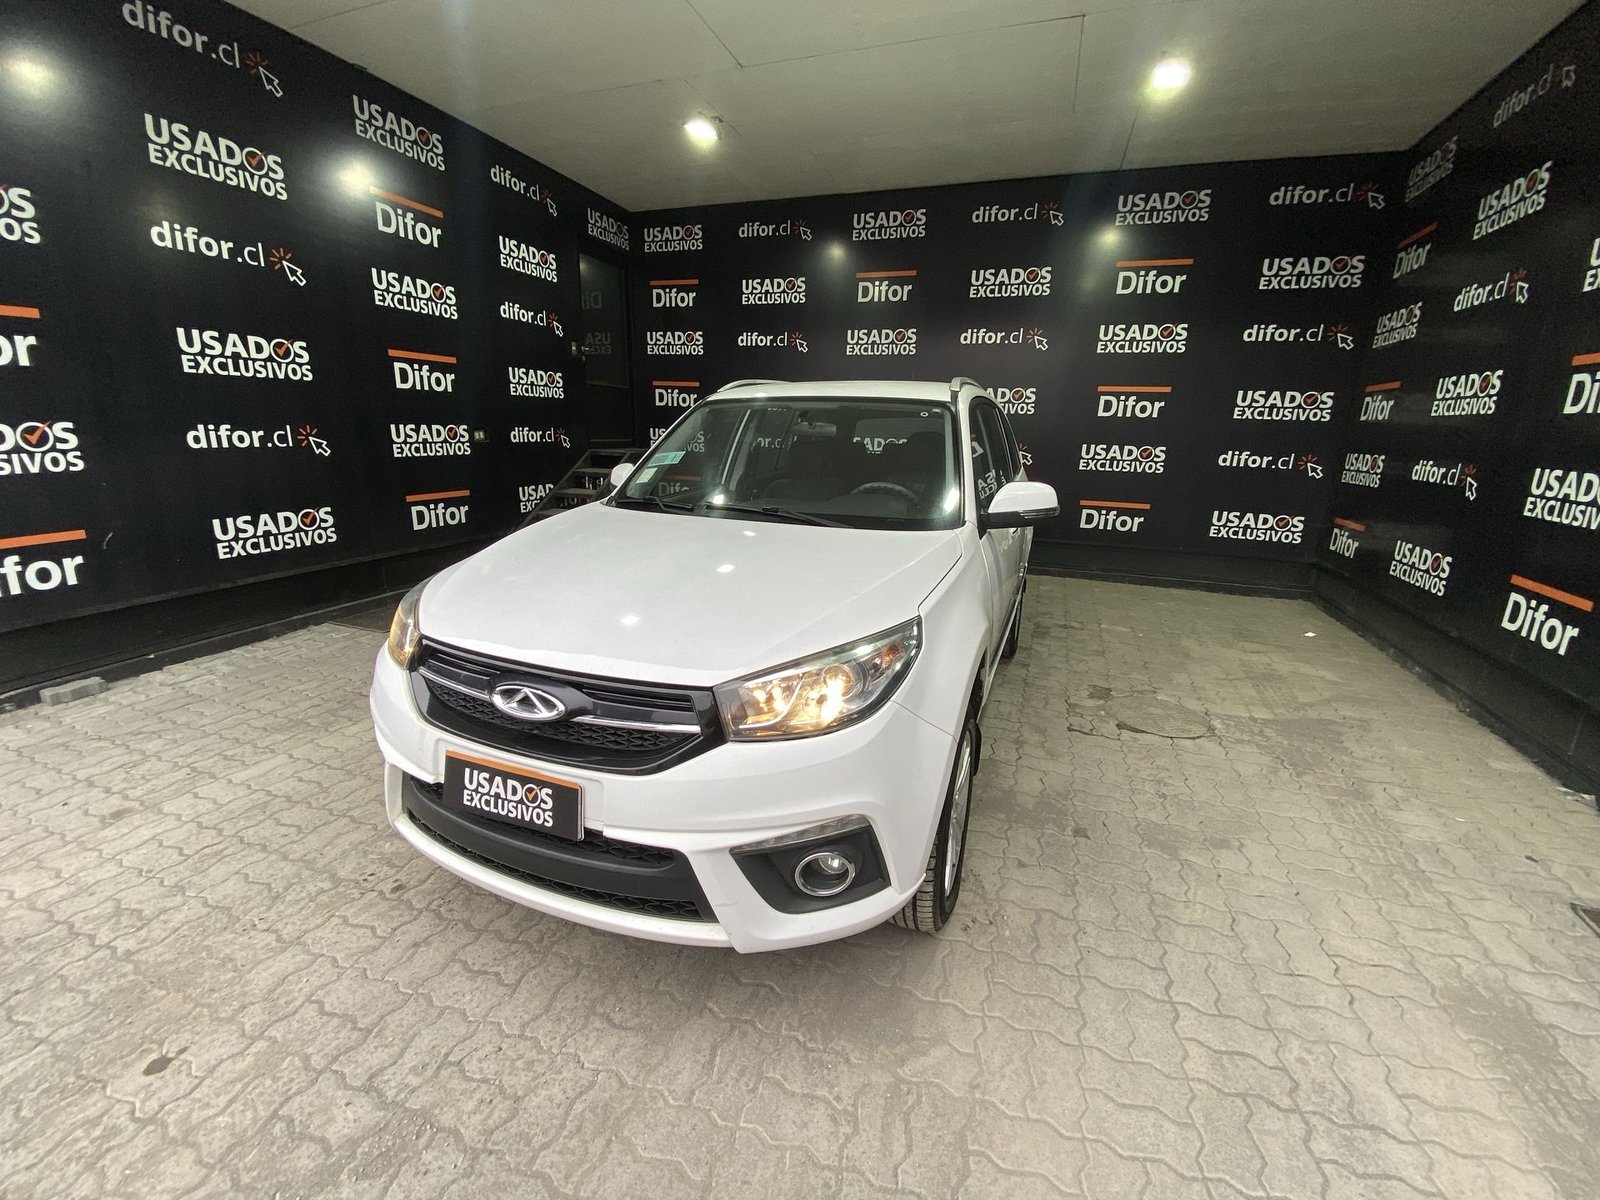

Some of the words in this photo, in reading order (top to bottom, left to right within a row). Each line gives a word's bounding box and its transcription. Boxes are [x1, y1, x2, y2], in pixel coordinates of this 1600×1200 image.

[122, 0, 241, 68] difor.cl
[1493, 64, 1554, 128] difor.cl
[353, 95, 443, 155] USADOS
[144, 113, 285, 180] USADOS
[355, 118, 445, 171] EXCLUSIVOS
[148, 142, 288, 201] EXCLUSIVOS
[490, 165, 539, 201] difor.cl
[1118, 189, 1211, 212] USADOS
[1269, 183, 1353, 206] difor.cl
[1478, 160, 1553, 219] USADOS
[376, 202, 441, 248] Difor
[588, 208, 629, 238] USADOS
[852, 209, 926, 229] USADOS
[972, 203, 1037, 224] difor.cl
[1115, 208, 1209, 226] EXCLUSIVOS
[1472, 190, 1547, 240] EXCLUSIVOS
[588, 226, 629, 250] EXCLUSIVOS
[644, 225, 703, 241] USADOS
[738, 220, 791, 238] difor.cl
[852, 225, 926, 241] EXCLUSIVOS
[150, 221, 265, 267] difor.cl
[499, 235, 556, 270] USADOS
[644, 238, 703, 252] EXCLUSIVOS
[500, 254, 557, 283] EXCLUSIVOS
[1262, 255, 1365, 276] USADOS
[1392, 242, 1430, 279] Difor
[371, 268, 456, 305] USADOS
[742, 277, 806, 293] USADOS
[971, 266, 1051, 286] USADOS
[1116, 270, 1187, 294] Difor
[1259, 274, 1361, 290] EXCLUSIVOS
[652, 288, 696, 308] Difor
[742, 292, 806, 305] EXCLUSIVOS
[857, 281, 912, 303] Difor
[969, 283, 1050, 298] EXCLUSIVOS
[1454, 272, 1509, 312] difor.cl
[374, 289, 458, 319] EXCLUSIVOS
[500, 301, 546, 326] difor.cl
[1377, 302, 1422, 334] USADOS
[647, 331, 703, 346] USADOS
[738, 332, 788, 348] difor.cl
[847, 328, 917, 344] USADOS
[960, 328, 1023, 345] difor.cl
[1099, 323, 1188, 340] USADOS
[1243, 324, 1324, 343] difor.cl
[1372, 325, 1416, 348] EXCLUSIVOS
[176, 327, 309, 364] USADOS
[647, 344, 704, 355] EXCLUSIVOS
[846, 342, 916, 356] EXCLUSIVOS
[1097, 339, 1187, 354] EXCLUSIVOS
[181, 354, 313, 381] EXCLUSIVOS
[393, 362, 455, 392] Difor
[509, 367, 563, 387] USADOS
[510, 383, 564, 399] EXCLUSIVOS
[986, 388, 1036, 403] ADOS
[1436, 369, 1503, 399] USADOS
[655, 389, 697, 407] Difor
[1097, 395, 1165, 418] Difor
[1236, 390, 1334, 409] USADOS
[1360, 396, 1394, 422] Difor
[1431, 396, 1497, 417] EXCLUSIVOS
[1233, 407, 1331, 422] EXCLUSIVOS
[0, 421, 78, 452] DOS
[186, 424, 293, 449] difor.cl
[390, 424, 469, 443] USADOS
[510, 427, 554, 443] difor.cl
[393, 442, 471, 458] EXCLUSIVOS
[1081, 443, 1166, 462] USADOS
[1218, 450, 1294, 470] difor.cl
[0, 451, 85, 476] SIVOS
[1079, 458, 1164, 474] EXCLUSIVOS
[1345, 453, 1385, 474] USADOS
[1412, 460, 1461, 486] difor.cl
[1341, 471, 1380, 488] EXCLUSIVOS
[1530, 468, 1600, 499] USAD
[212, 507, 334, 541] USADOS
[411, 503, 468, 531] Difor
[1079, 508, 1144, 533] Difor
[1212, 510, 1305, 532] USADOS
[216, 528, 337, 560] EXCLUSIVOS
[1209, 525, 1302, 544] EXCLUSIVOS
[1329, 528, 1358, 559] Difor
[1394, 540, 1452, 579] USADOS
[0, 555, 84, 596] for
[1389, 560, 1446, 597] EXCLUSIVOS
[1501, 592, 1579, 656] Difor
[464, 768, 553, 810] USADOS
[463, 789, 553, 827] EXCLUSIVOS
